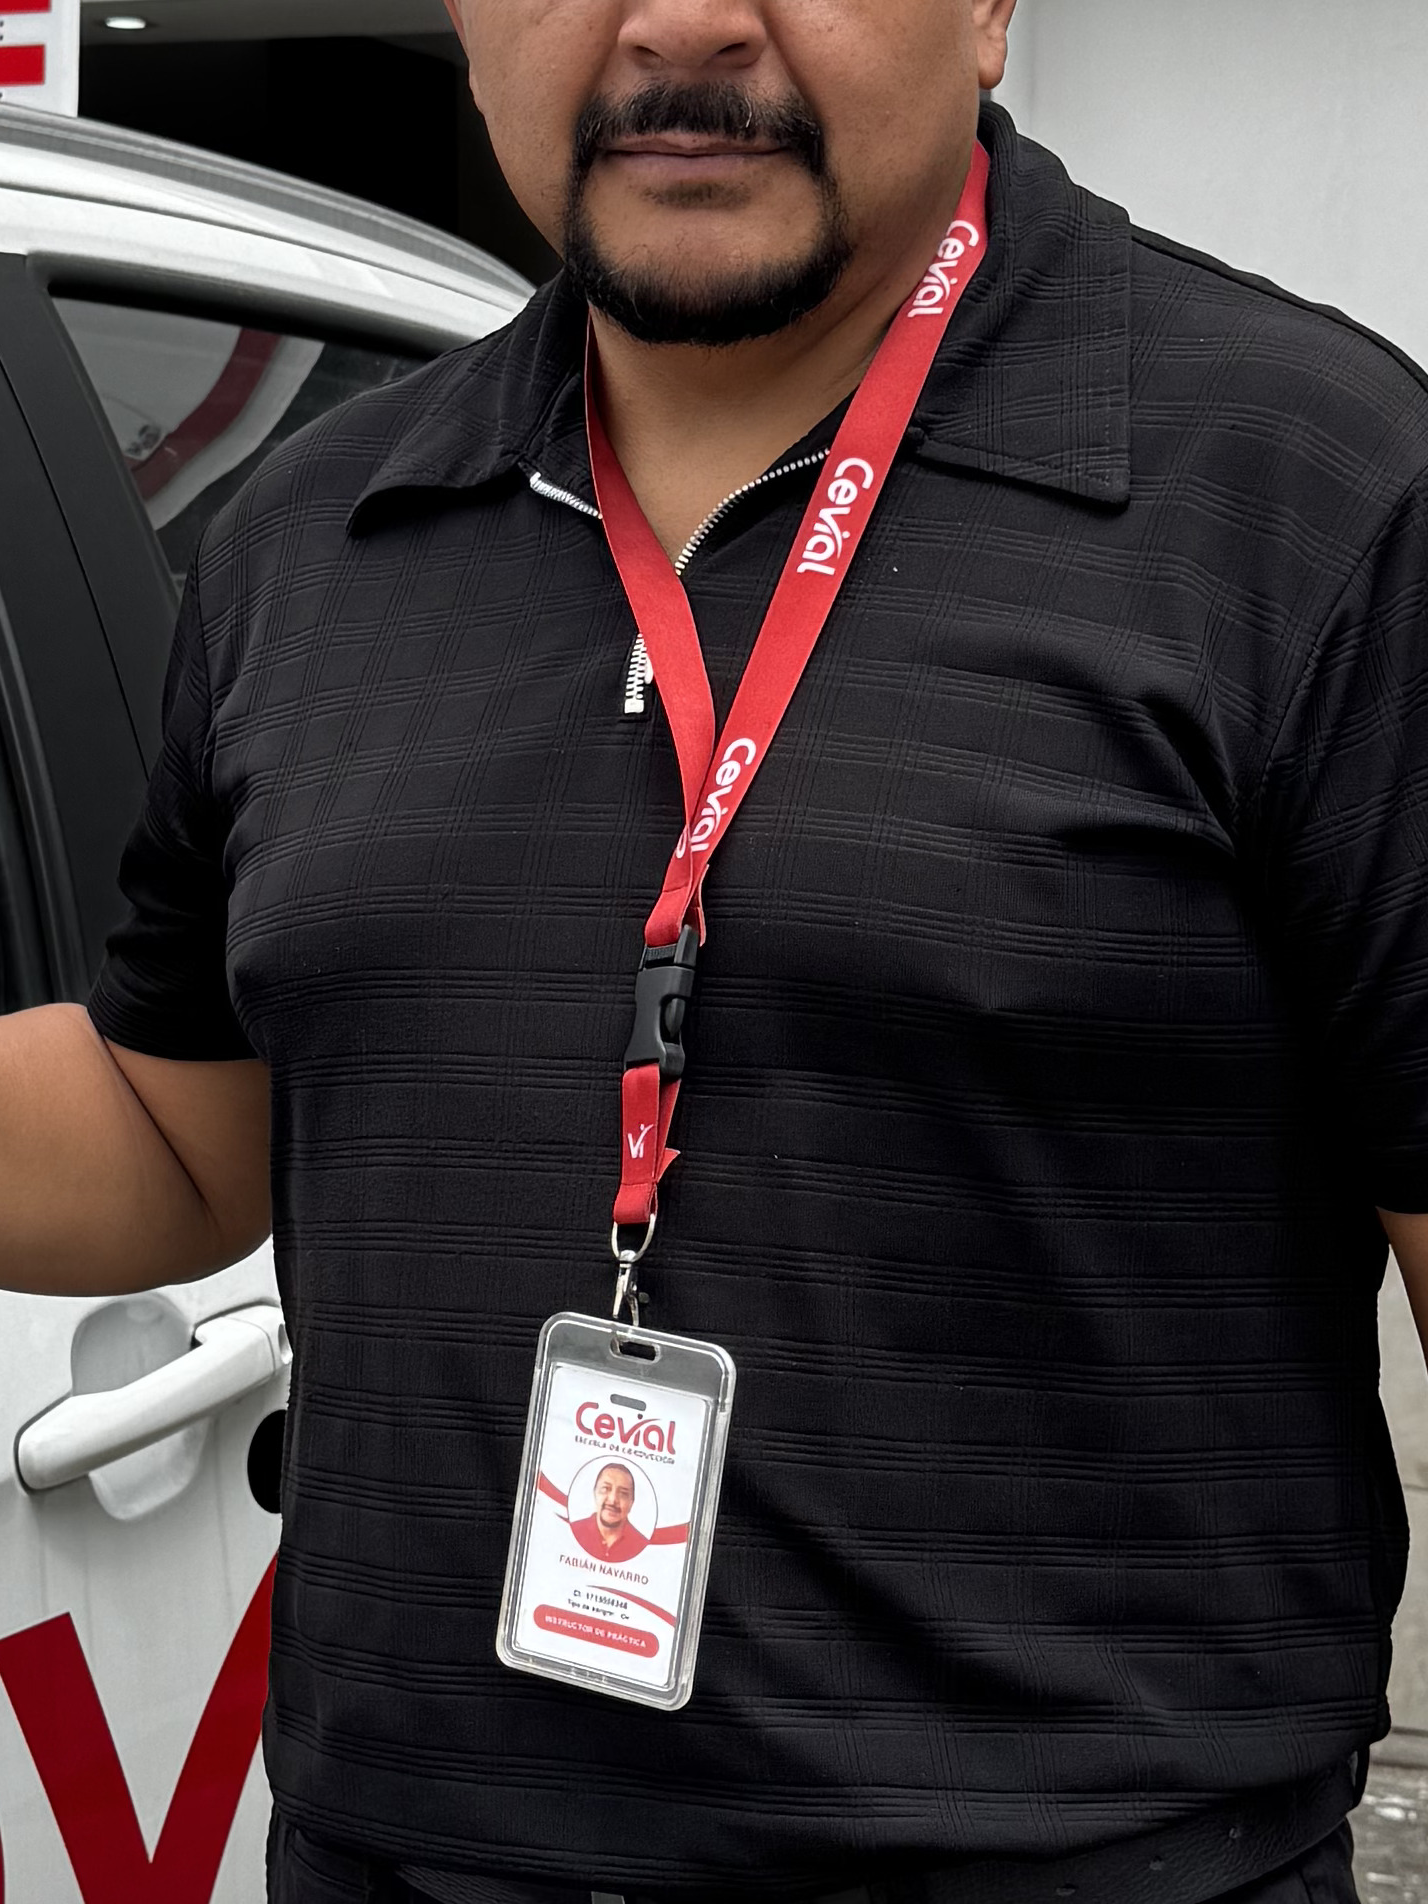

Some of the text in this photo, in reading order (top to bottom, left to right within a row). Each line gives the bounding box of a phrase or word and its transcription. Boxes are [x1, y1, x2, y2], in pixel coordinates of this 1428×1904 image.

[907, 219, 979, 318] Cevial
[797, 457, 874, 576] Cevial
[690, 737, 757, 853] Cevial
[575, 1401, 676, 1455] Cevial
[559, 1554, 650, 1585] FABIÁN NAVARRO
